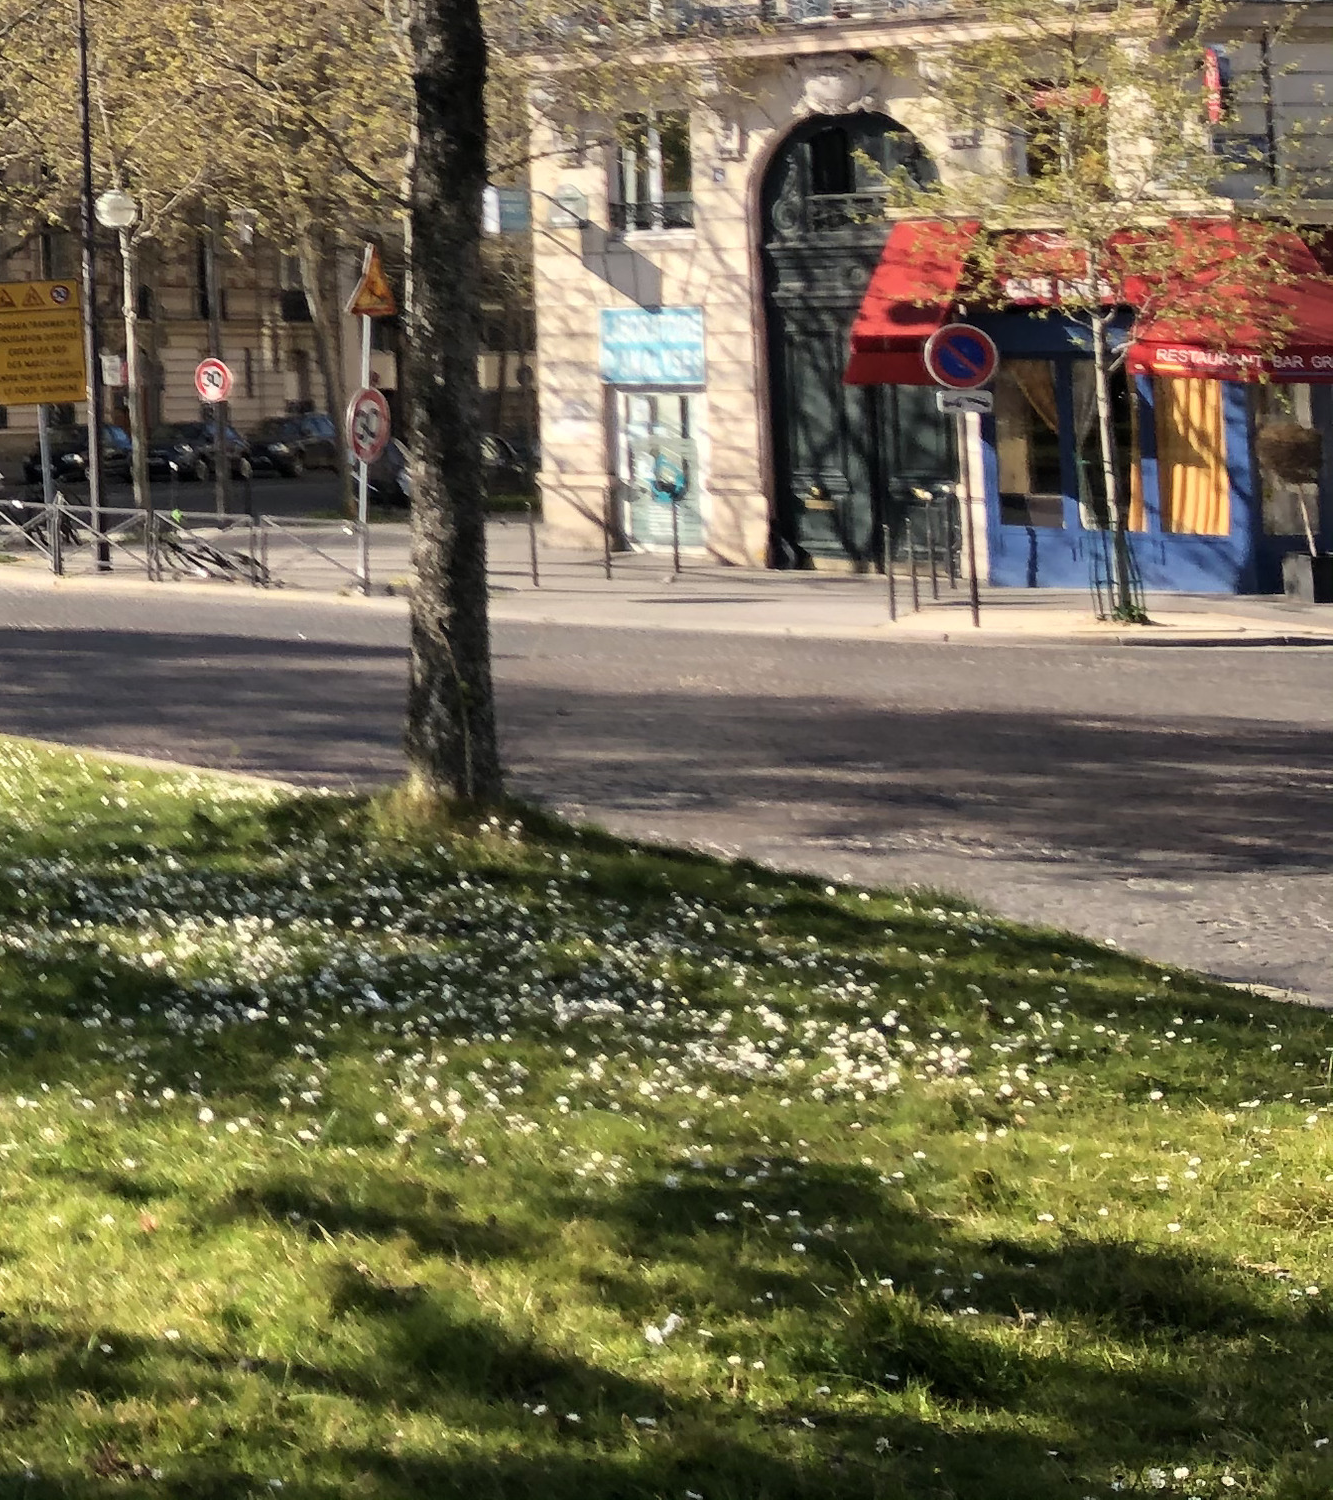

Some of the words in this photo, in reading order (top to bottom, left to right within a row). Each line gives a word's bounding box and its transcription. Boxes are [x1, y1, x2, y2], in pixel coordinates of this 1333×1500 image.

[1156, 349, 1263, 368] RESTAURANT
[1272, 355, 1304, 368] BAR
[202, 368, 222, 388] 30
